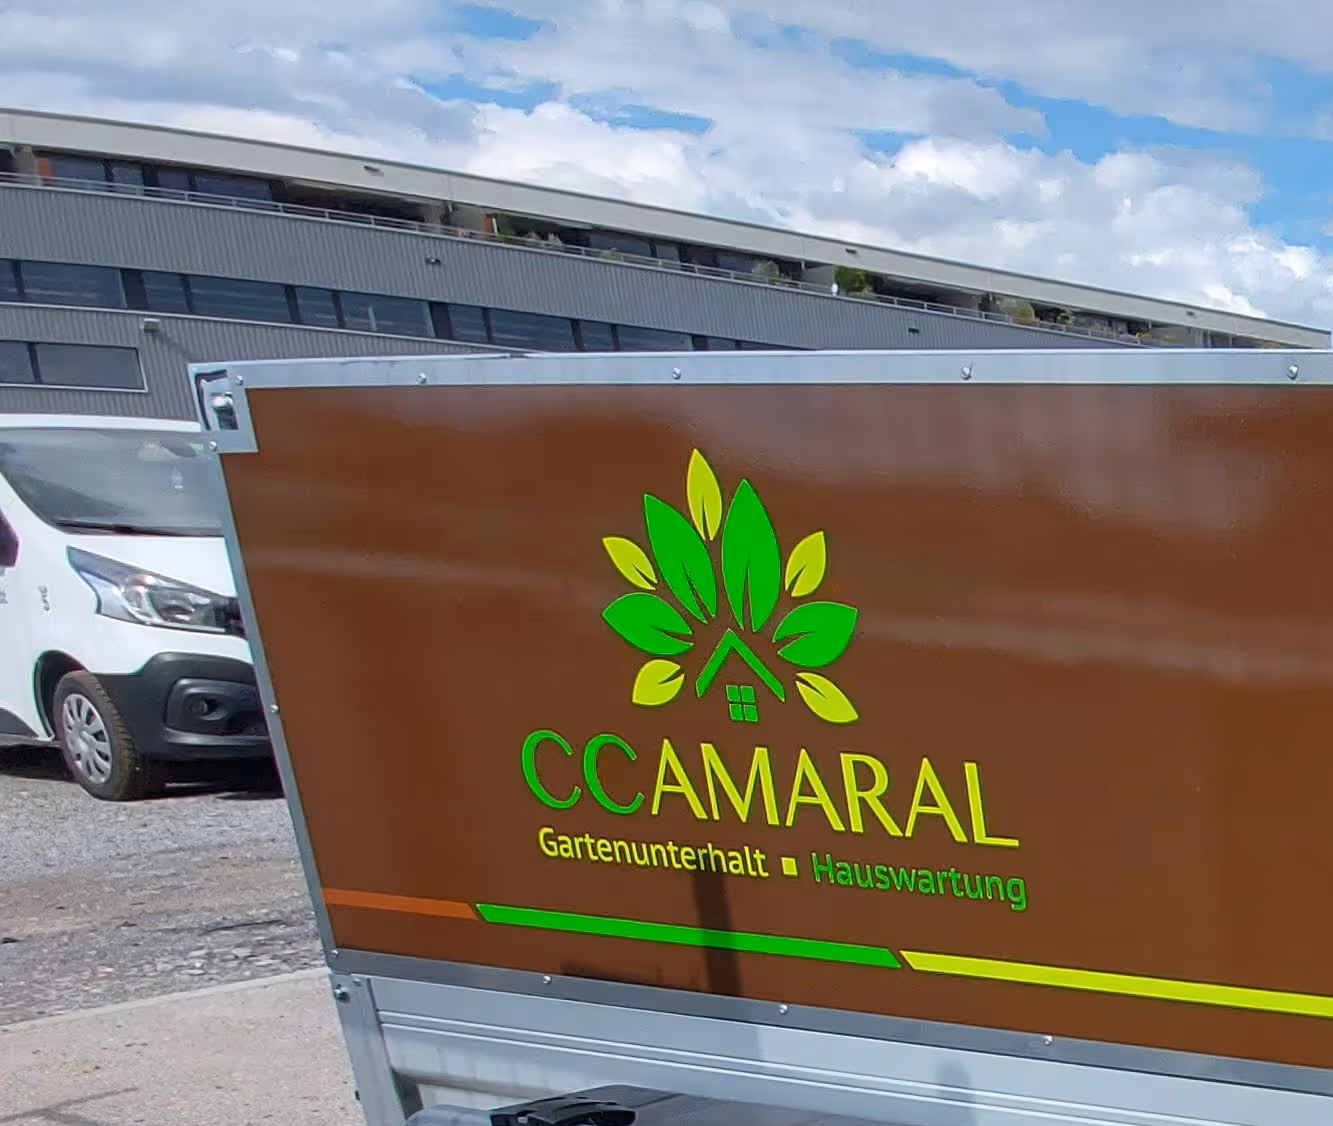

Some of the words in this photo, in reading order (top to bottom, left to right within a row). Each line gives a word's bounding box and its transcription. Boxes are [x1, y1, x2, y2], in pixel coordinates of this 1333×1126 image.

[521, 729, 1020, 848] CCAMARAL
[538, 827, 770, 878] Gartenunterhalt
[811, 853, 1028, 912] Hauswartung
